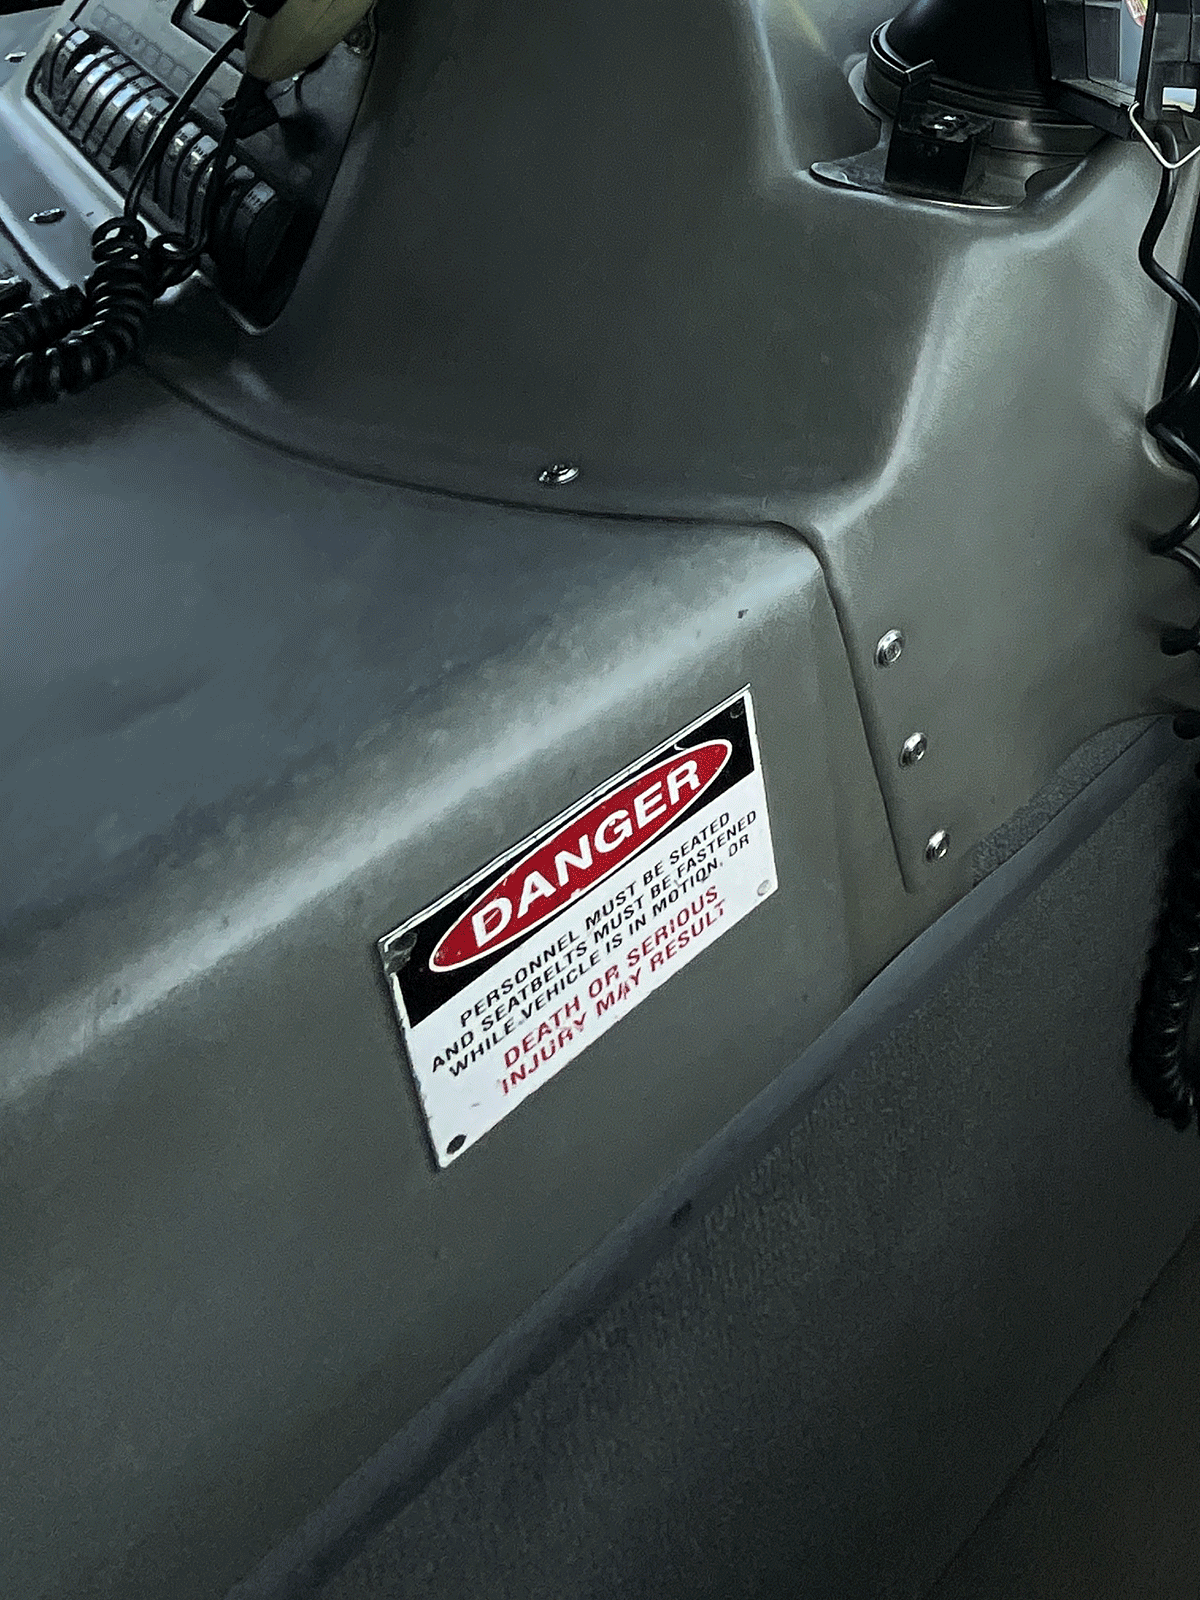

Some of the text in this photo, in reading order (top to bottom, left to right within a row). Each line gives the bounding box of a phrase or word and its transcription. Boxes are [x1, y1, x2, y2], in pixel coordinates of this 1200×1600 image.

[432, 810, 757, 1072] AND SEATBELTS MUST BE FASTENED
[449, 1015, 515, 1077] WHILE
[521, 952, 601, 1019] VEHICLE
[606, 933, 623, 955] IS
[629, 915, 647, 935] IN
[728, 834, 750, 858] OR
[460, 812, 730, 1027] PERSONNEL MUST BE SEATED
[469, 758, 701, 948] DANGER
[500, 898, 725, 1094] INJURY MAY RESULT
[503, 885, 719, 1069] DEATH OR SERIOUS
